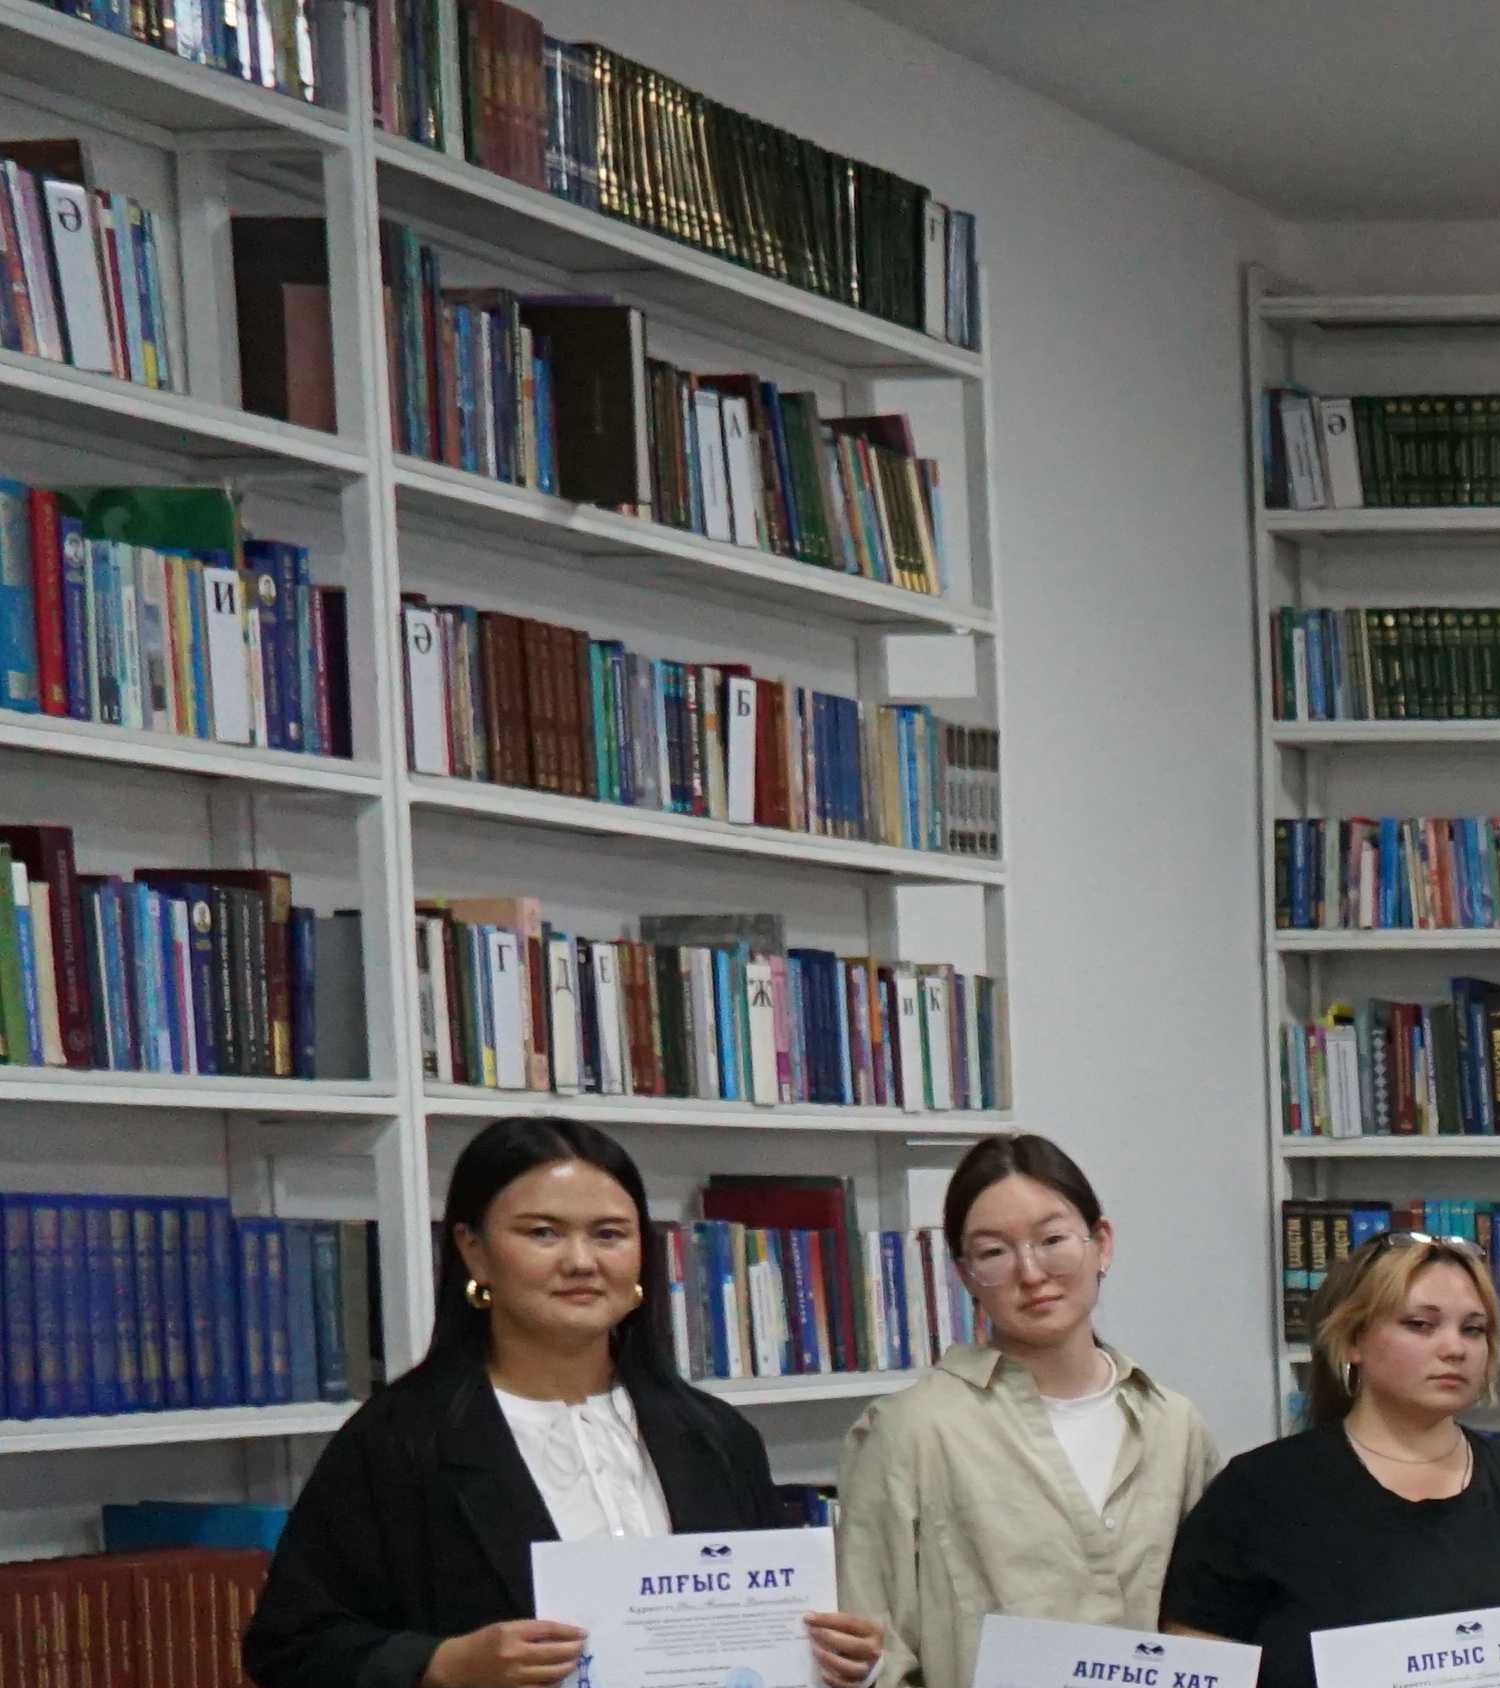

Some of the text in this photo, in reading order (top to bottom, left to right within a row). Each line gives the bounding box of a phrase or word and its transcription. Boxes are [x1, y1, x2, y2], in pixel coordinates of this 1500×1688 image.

[213, 580, 236, 615] И
[748, 979, 774, 1007] Ж
[640, 1567, 795, 1596] АЛҒЫС ХАТ
[1072, 1660, 1159, 1686] АЛҒЫС
[1407, 1646, 1485, 1673] АЛҒЫС
